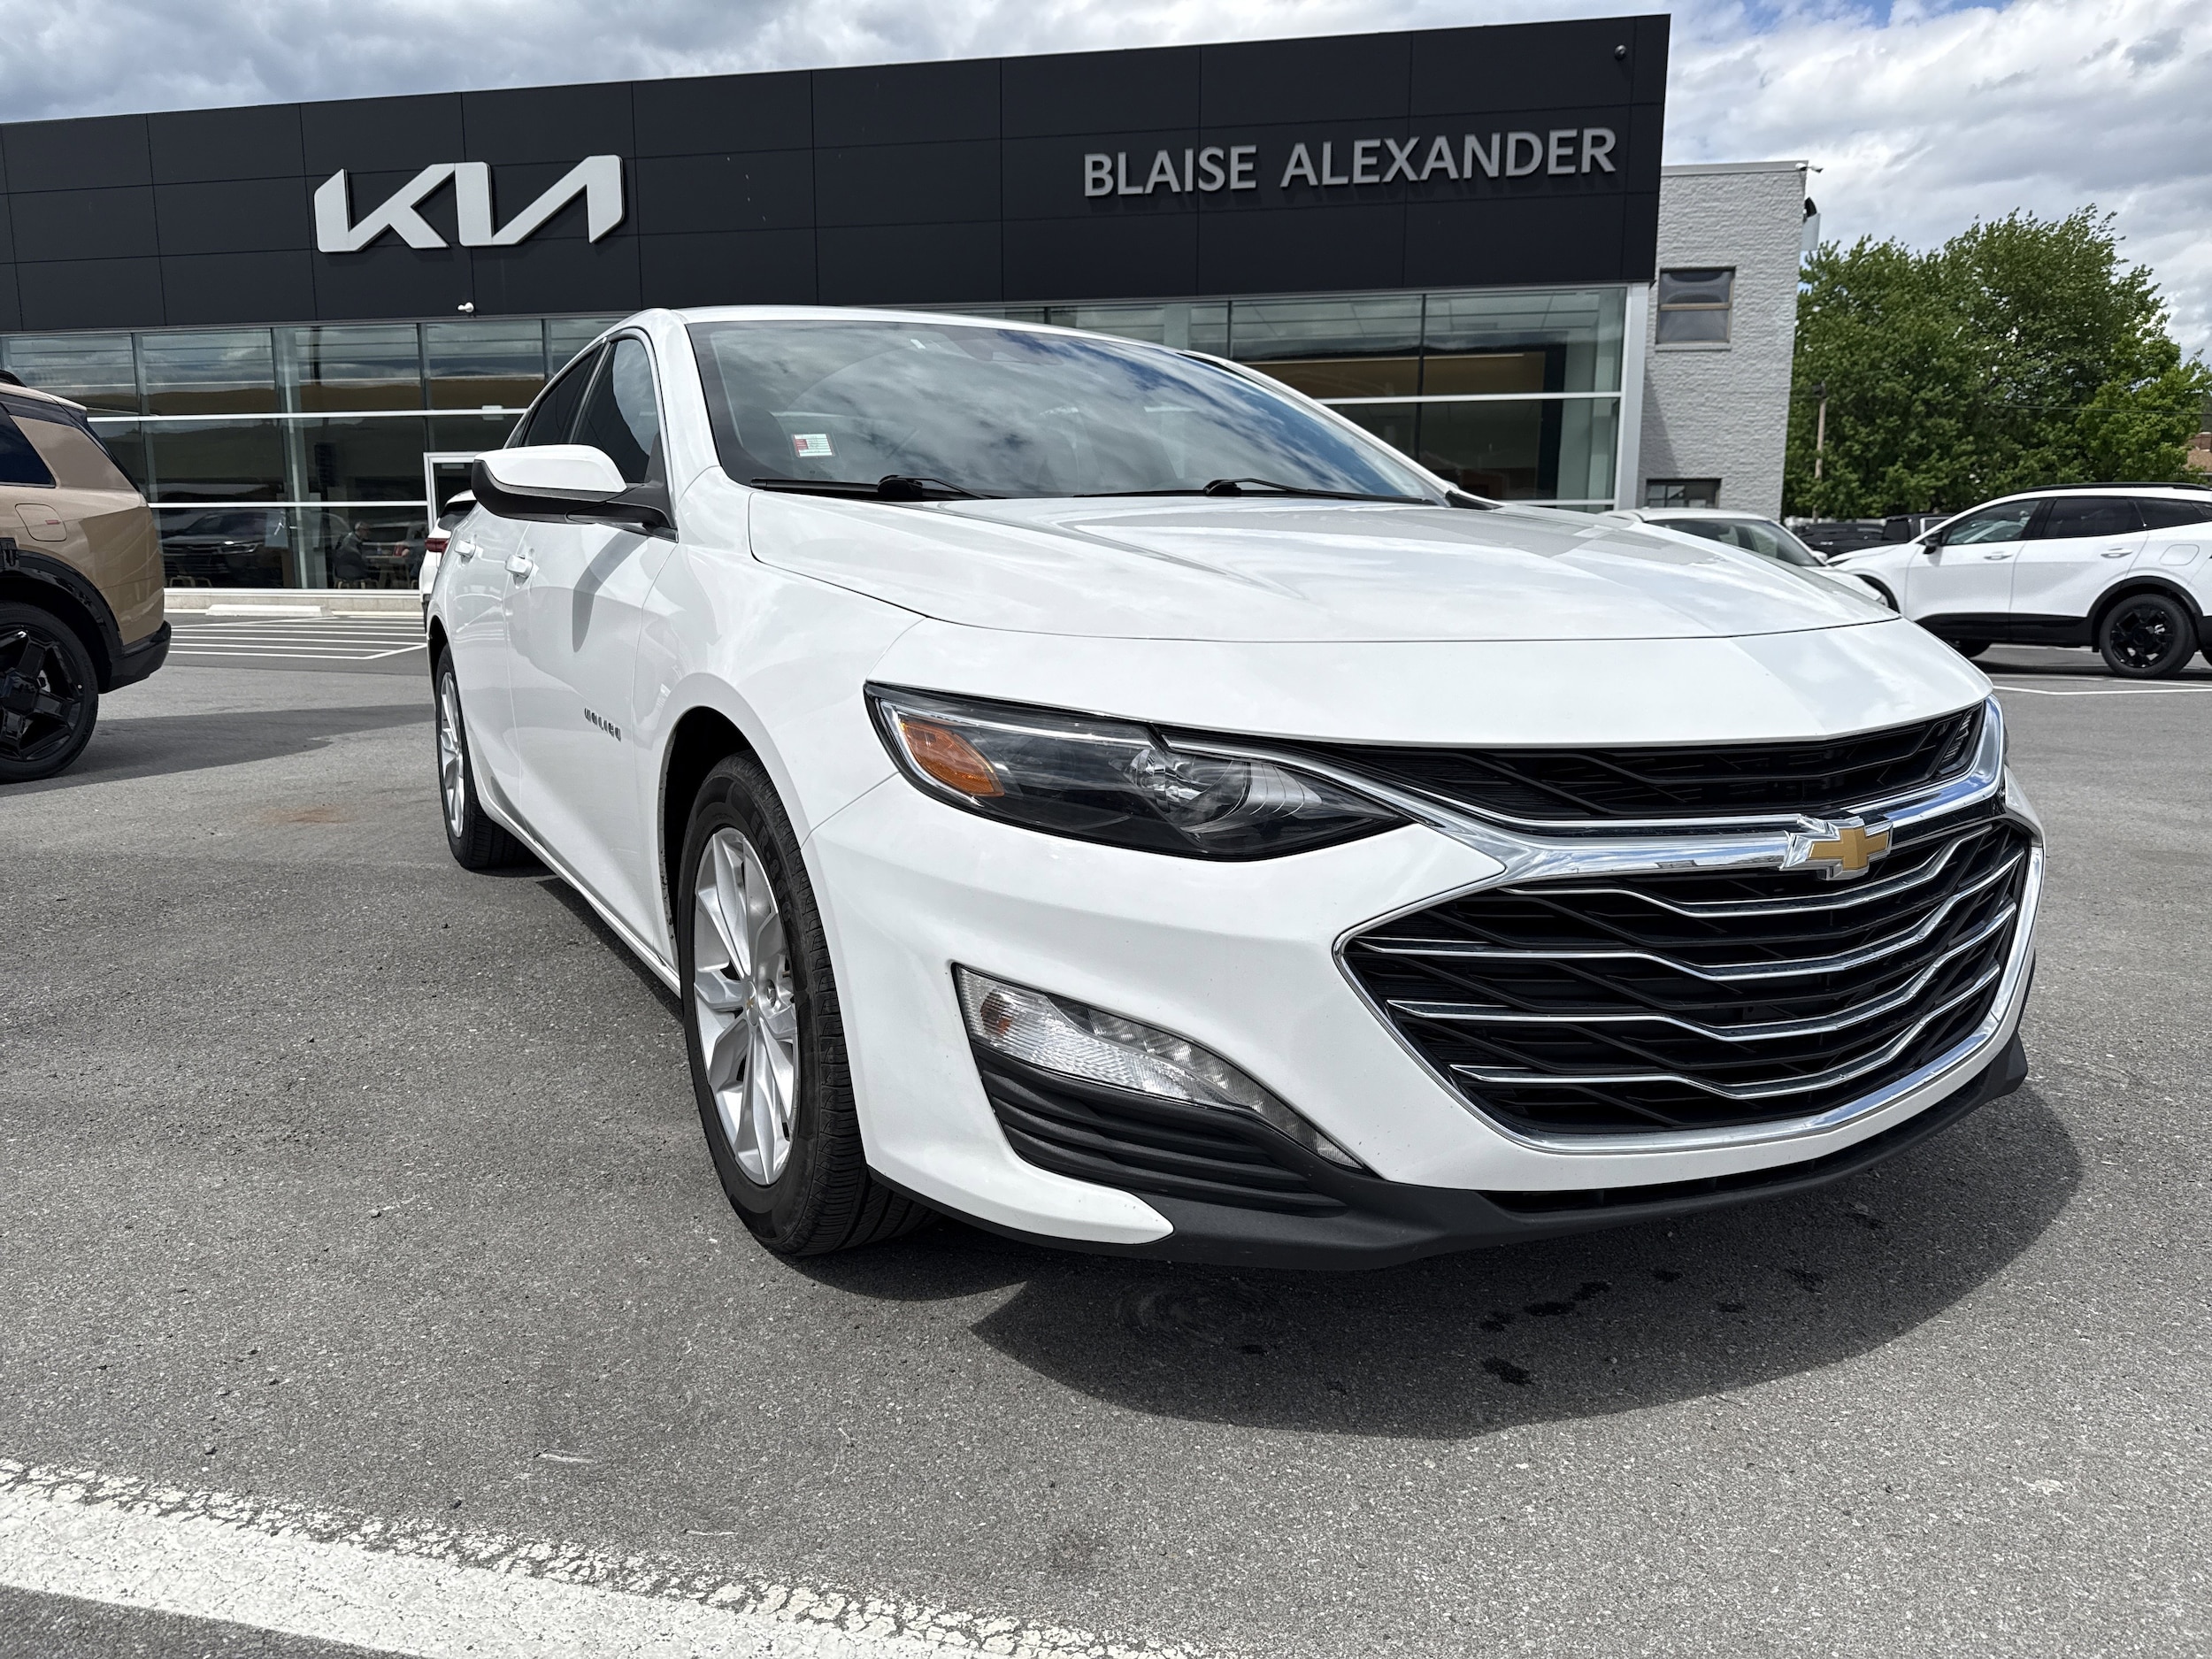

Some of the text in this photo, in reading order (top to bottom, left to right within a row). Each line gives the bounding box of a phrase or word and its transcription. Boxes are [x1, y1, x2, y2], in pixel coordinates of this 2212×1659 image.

[313, 154, 625, 254] KIA
[1083, 127, 1617, 197] BLAISE ALEXANDER
